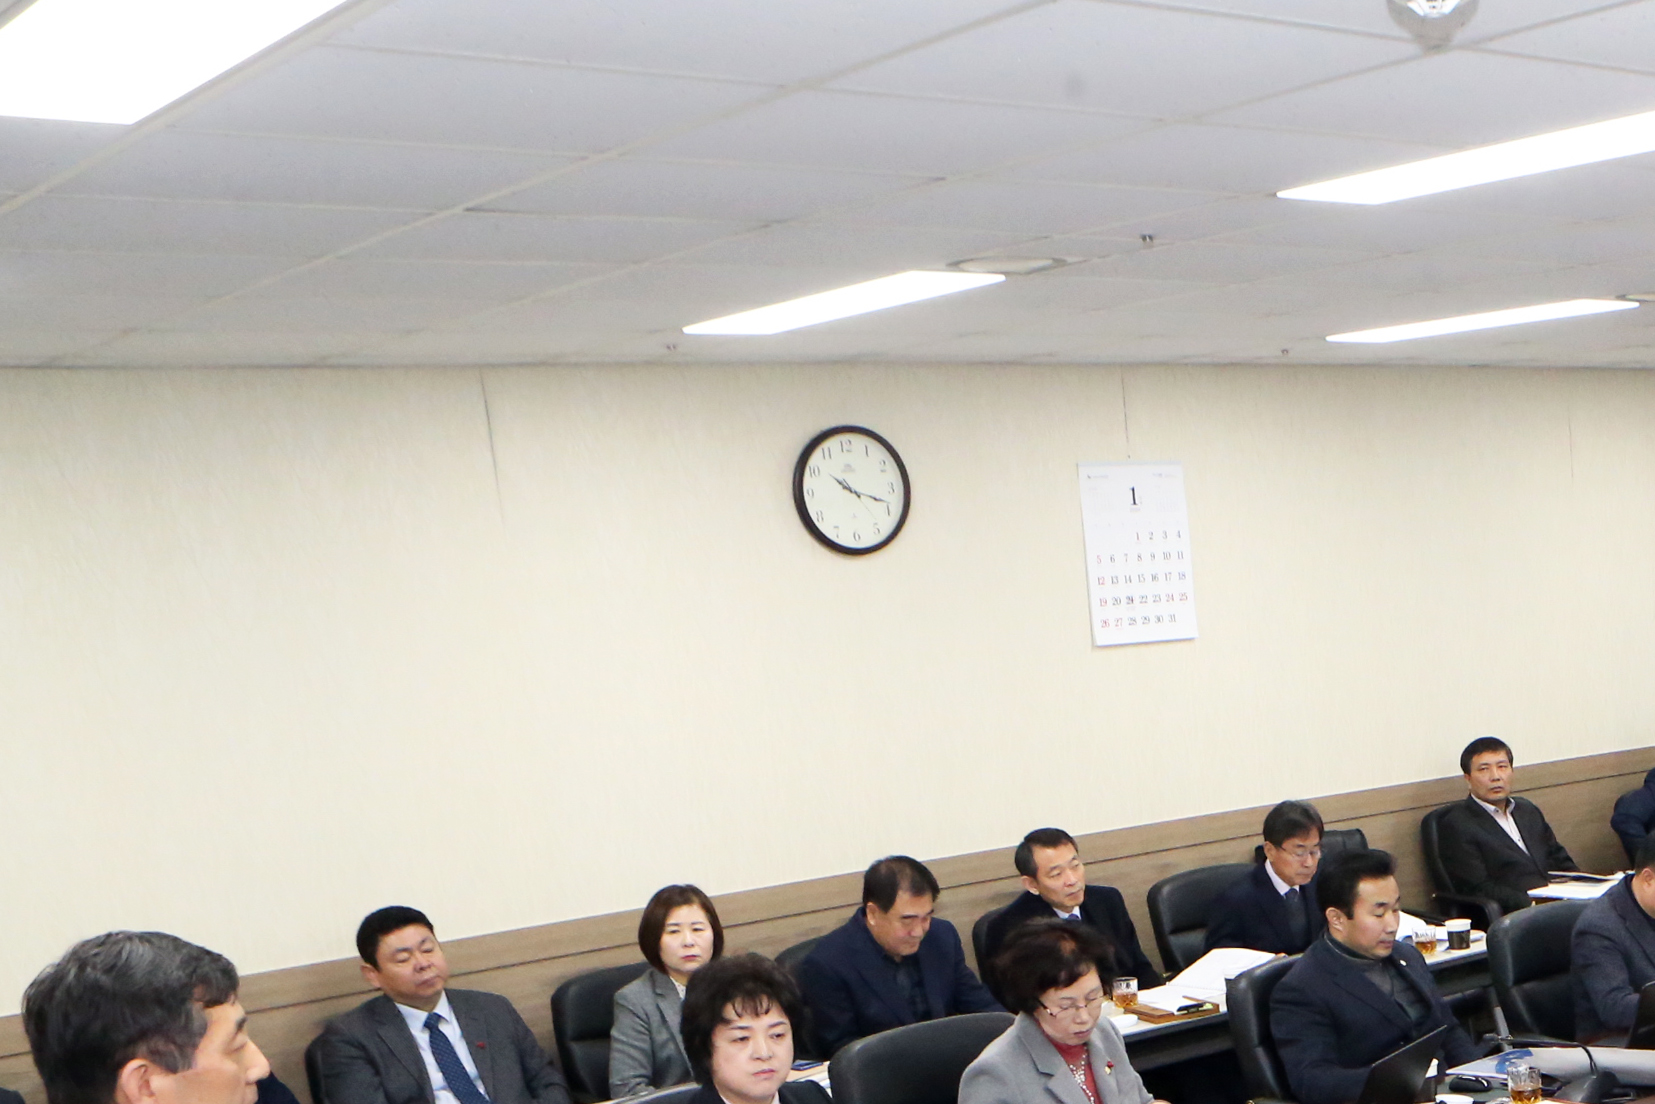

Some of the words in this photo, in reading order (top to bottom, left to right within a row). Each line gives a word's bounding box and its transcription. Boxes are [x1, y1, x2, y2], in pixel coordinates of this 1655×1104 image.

[822, 446, 832, 460] 11
[840, 439, 853, 453] 12
[865, 444, 869, 457] 1
[809, 465, 820, 478] 10
[880, 459, 887, 473] 2
[807, 488, 814, 499] 9
[888, 481, 895, 494] 3
[1129, 486, 1139, 506] 1
[816, 510, 824, 523] 8
[834, 525, 840, 539] 7
[853, 528, 861, 542] 6
[873, 522, 880, 535] 5
[1136, 532, 1140, 541] 1
[1148, 531, 1154, 540] 2
[1162, 530, 1168, 540] 3
[1176, 530, 1181, 539] 4
[1096, 554, 1102, 564] 5
[1110, 554, 1115, 563] 6
[1124, 553, 1128, 563] 7
[1137, 552, 1142, 562] 8
[1150, 552, 1155, 561] 9
[1162, 551, 1171, 560] 10
[1177, 550, 1184, 560] 11
[1097, 576, 1105, 586] 12
[1111, 575, 1119, 585] 13
[1124, 574, 1132, 584] 14
[1137, 573, 1146, 583] 15
[1151, 573, 1159, 582] 16
[1164, 572, 1172, 581] 17
[1178, 571, 1186, 581] 18
[1099, 597, 1108, 607] 19
[1112, 596, 1122, 606] 20
[1126, 595, 1134, 605] 21
[1139, 594, 1148, 604] 22
[1152, 593, 1162, 603] 23
[1165, 593, 1175, 603] 24
[1179, 592, 1188, 602] 25
[1101, 618, 1110, 628] 26
[1114, 617, 1123, 627] 27
[1128, 616, 1137, 626] 28
[1141, 615, 1151, 625] 29
[1154, 614, 1164, 624] 30
[1168, 613, 1176, 623] 31
